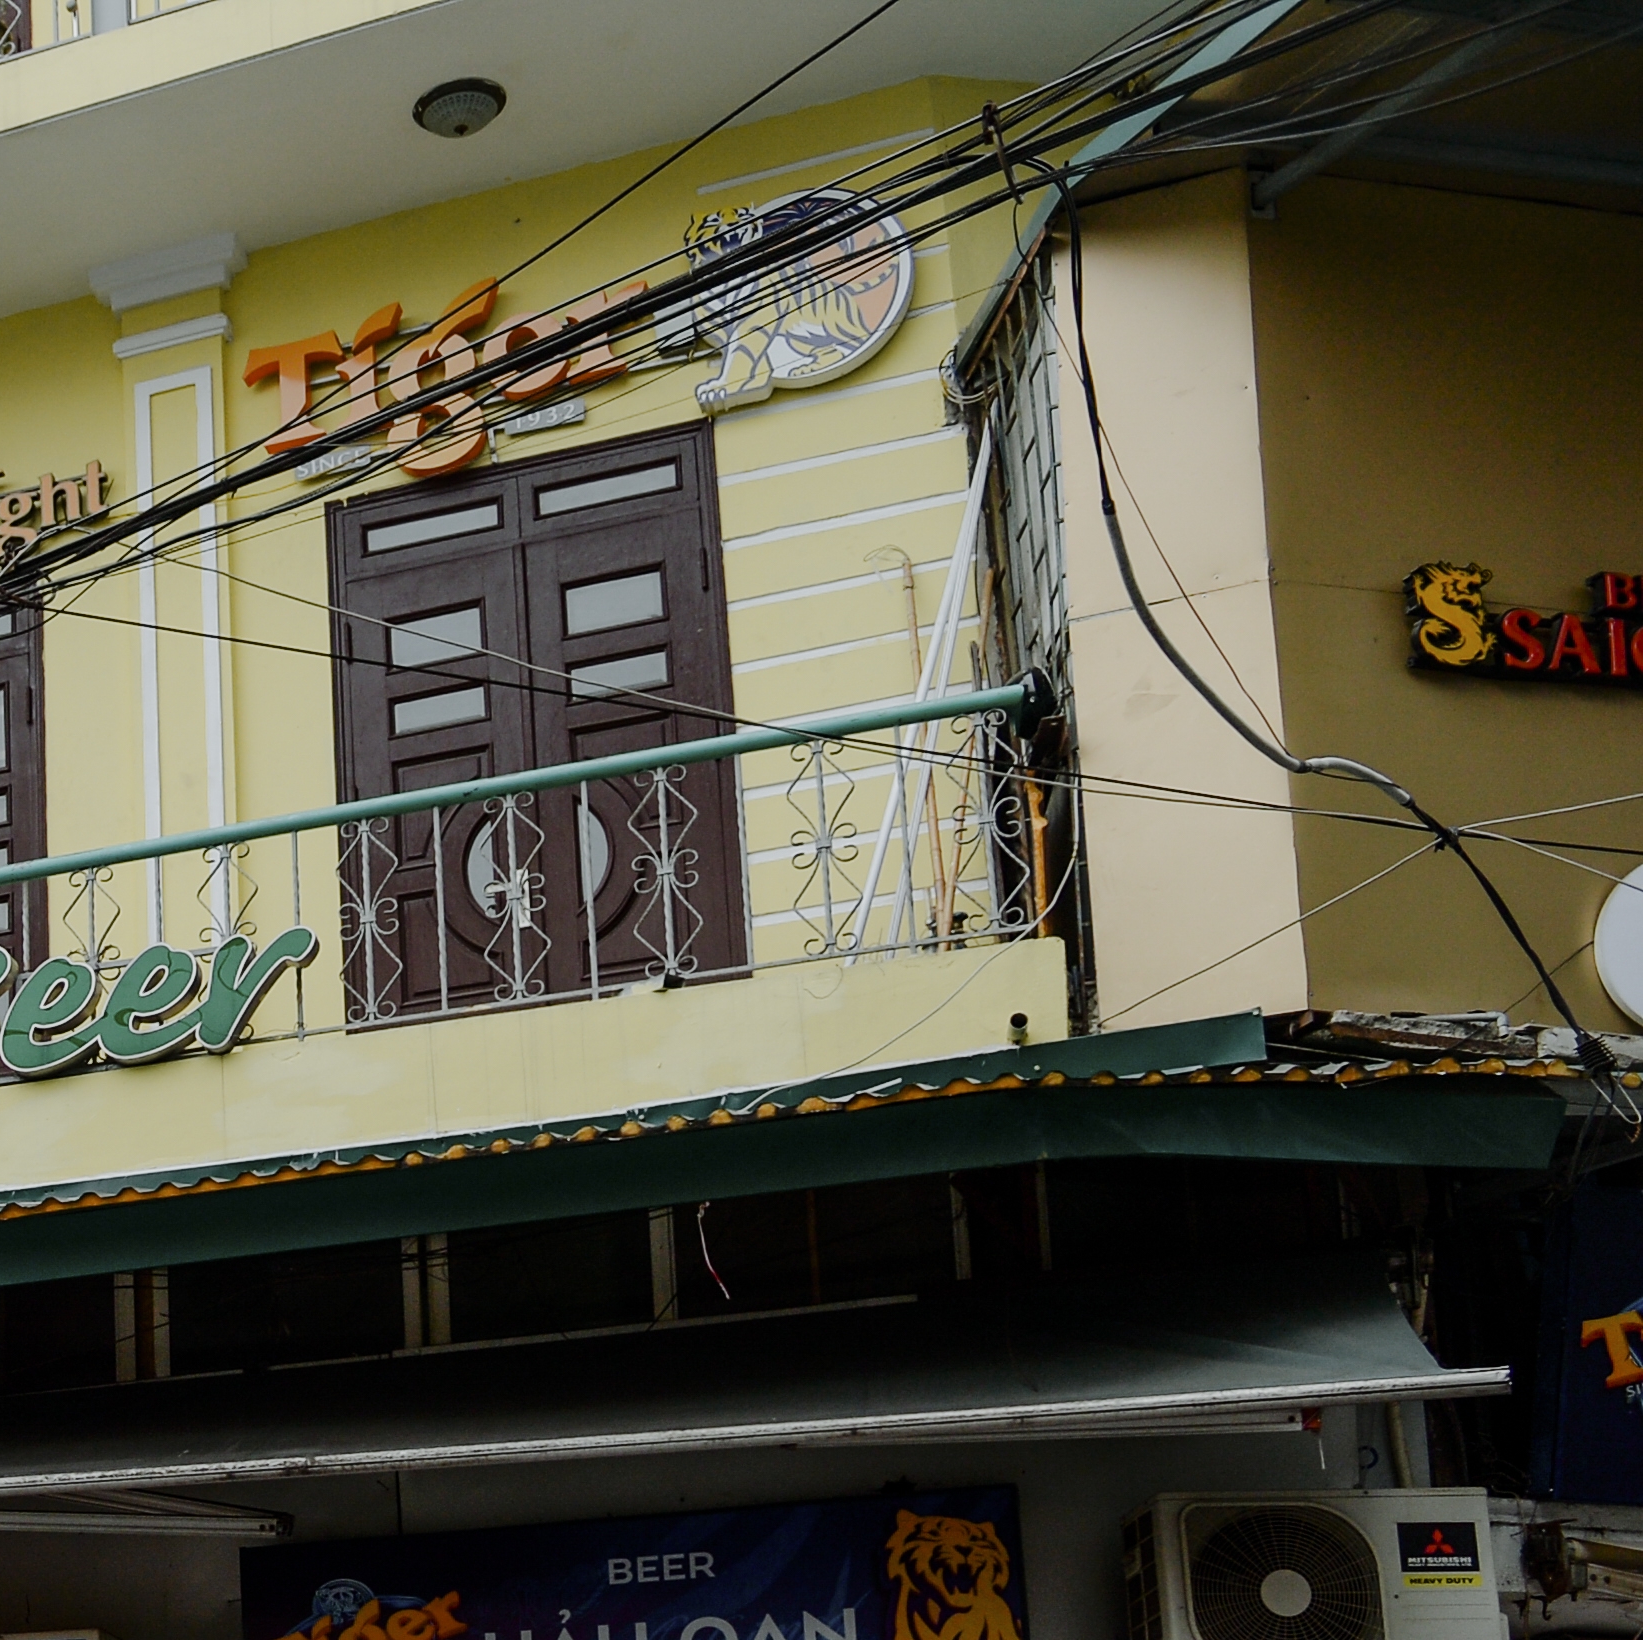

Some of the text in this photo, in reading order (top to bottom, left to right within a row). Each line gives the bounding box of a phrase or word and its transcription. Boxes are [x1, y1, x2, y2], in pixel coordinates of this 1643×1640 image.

[1407, 1556, 1473, 1565] MITSUBISHI
[607, 1551, 716, 1586] BEER
[1409, 1577, 1443, 1585] HEAVY
